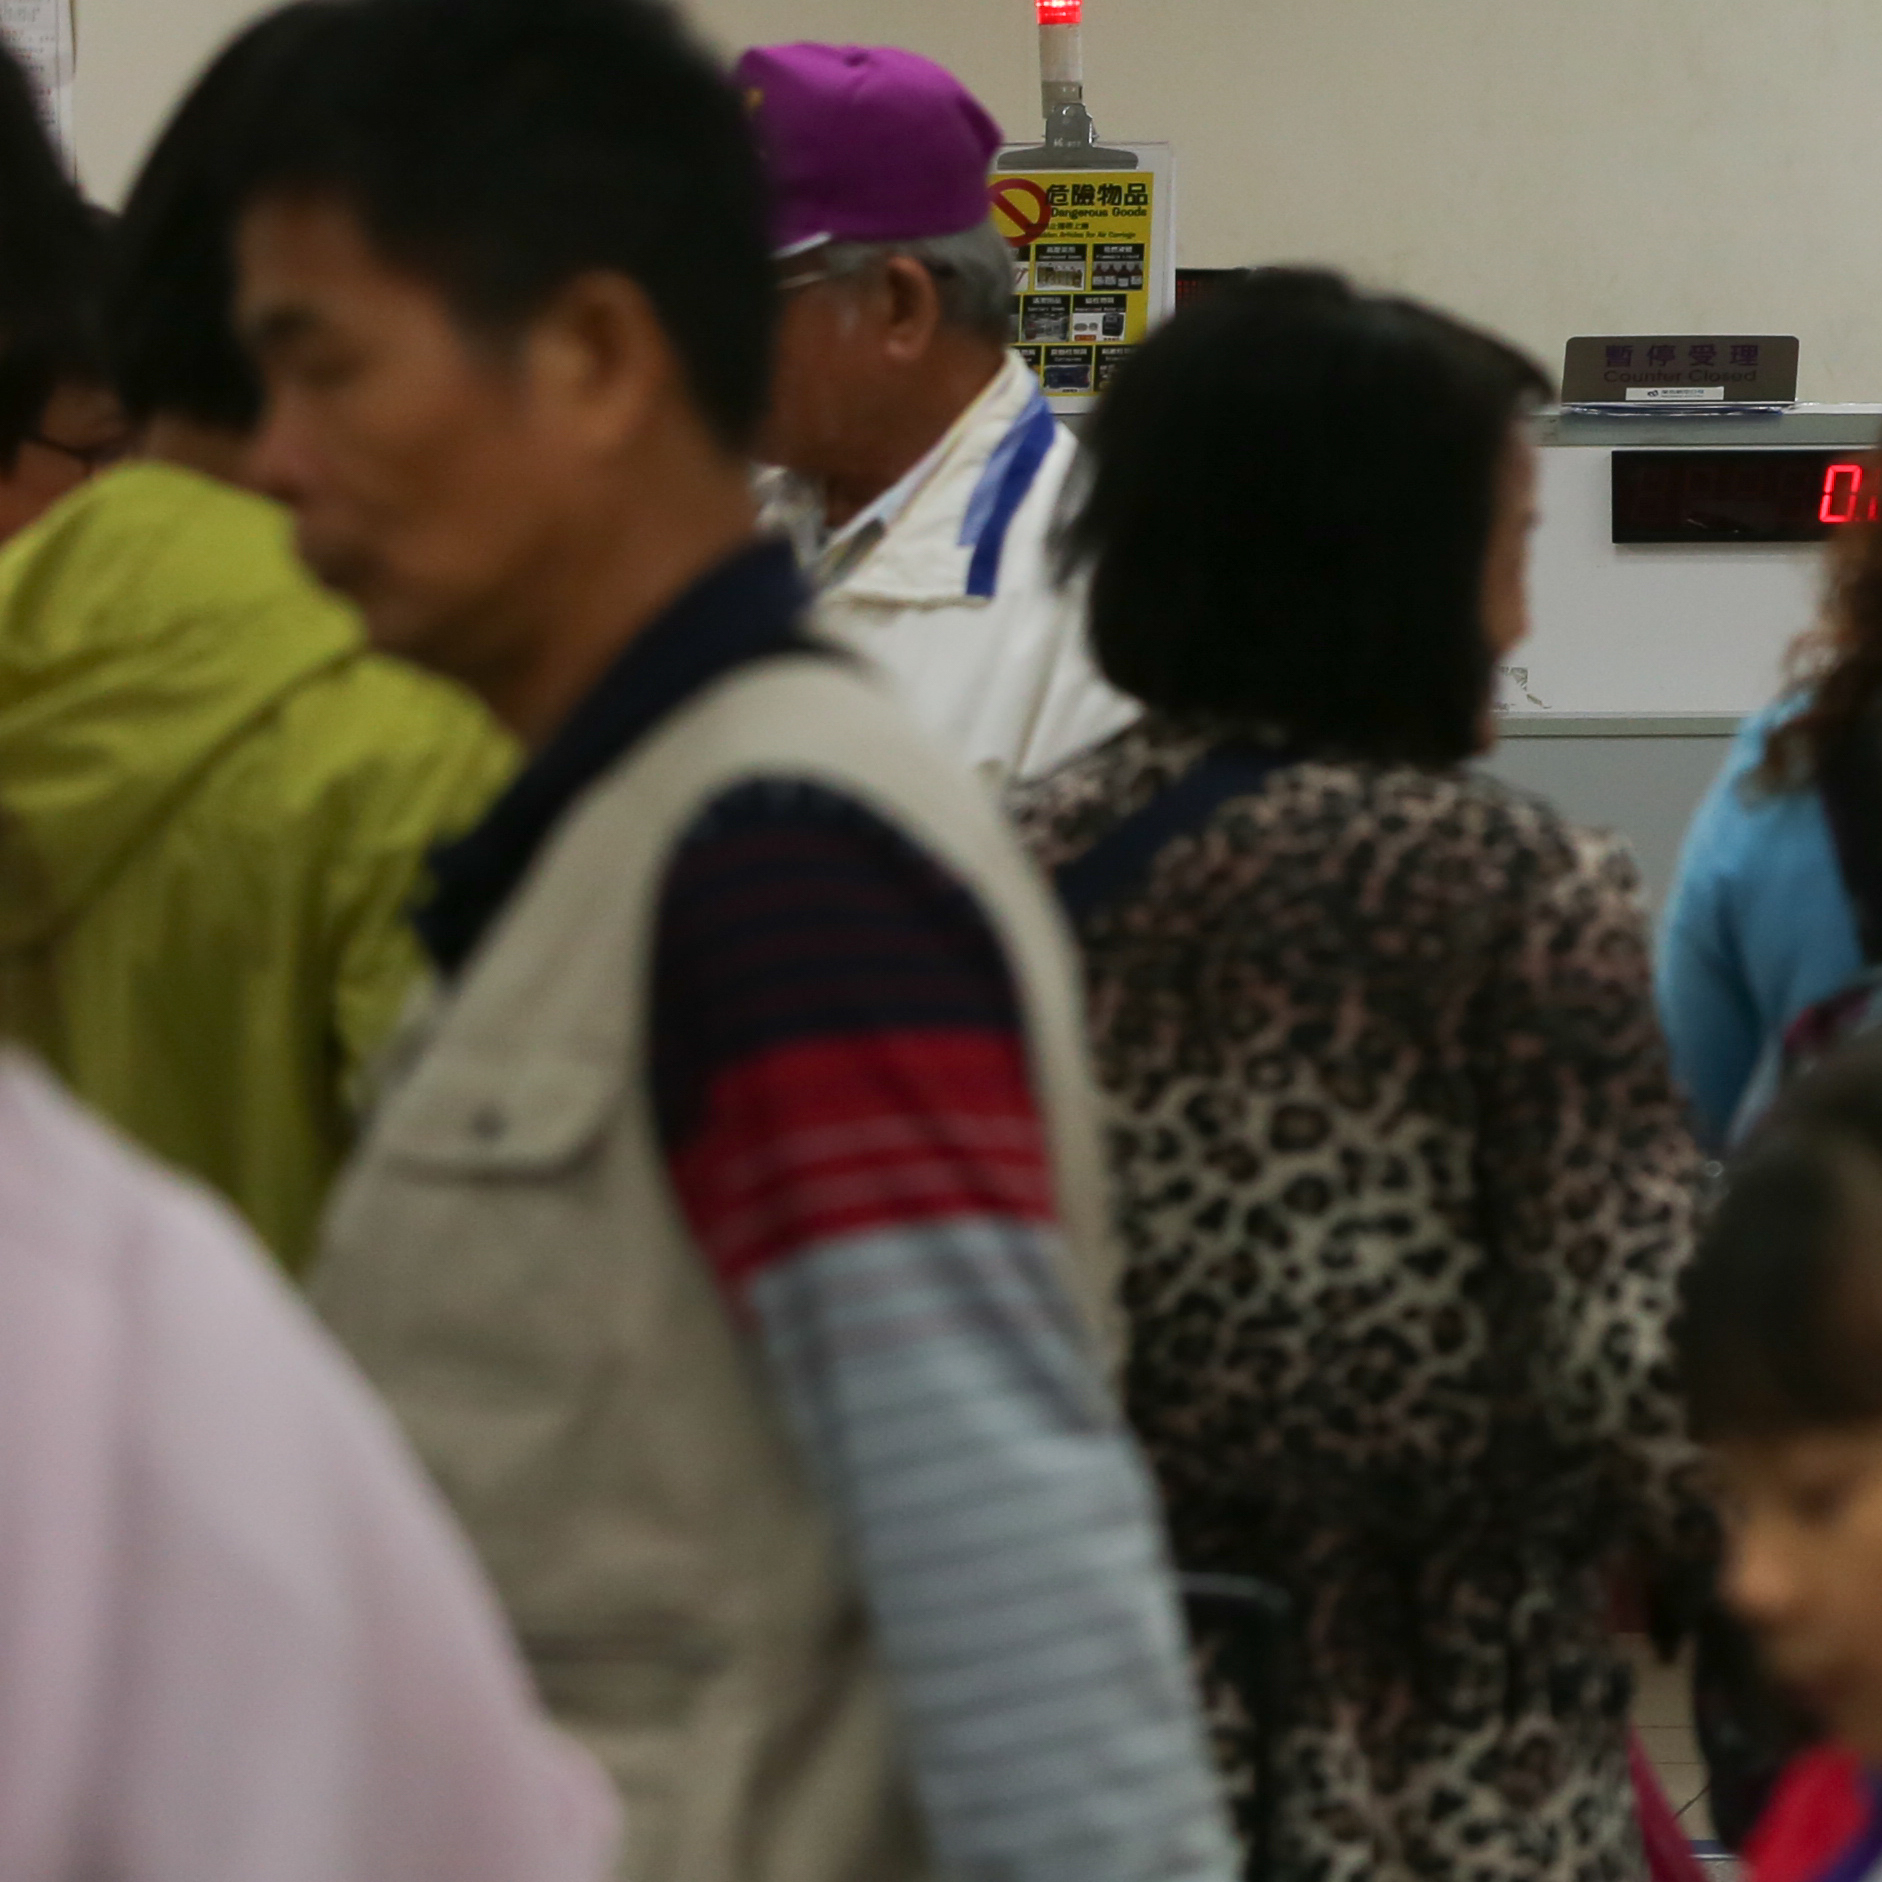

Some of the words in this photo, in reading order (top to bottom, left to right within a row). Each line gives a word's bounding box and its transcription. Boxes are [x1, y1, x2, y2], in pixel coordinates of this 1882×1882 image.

[1047, 183, 1149, 206] 危險物品
[1051, 207, 1109, 219] Dangerous
[1112, 207, 1147, 217] Goods
[1604, 344, 1759, 368] 暫停受理
[1603, 369, 1682, 383] Counter
[1688, 369, 1758, 383] Closed
